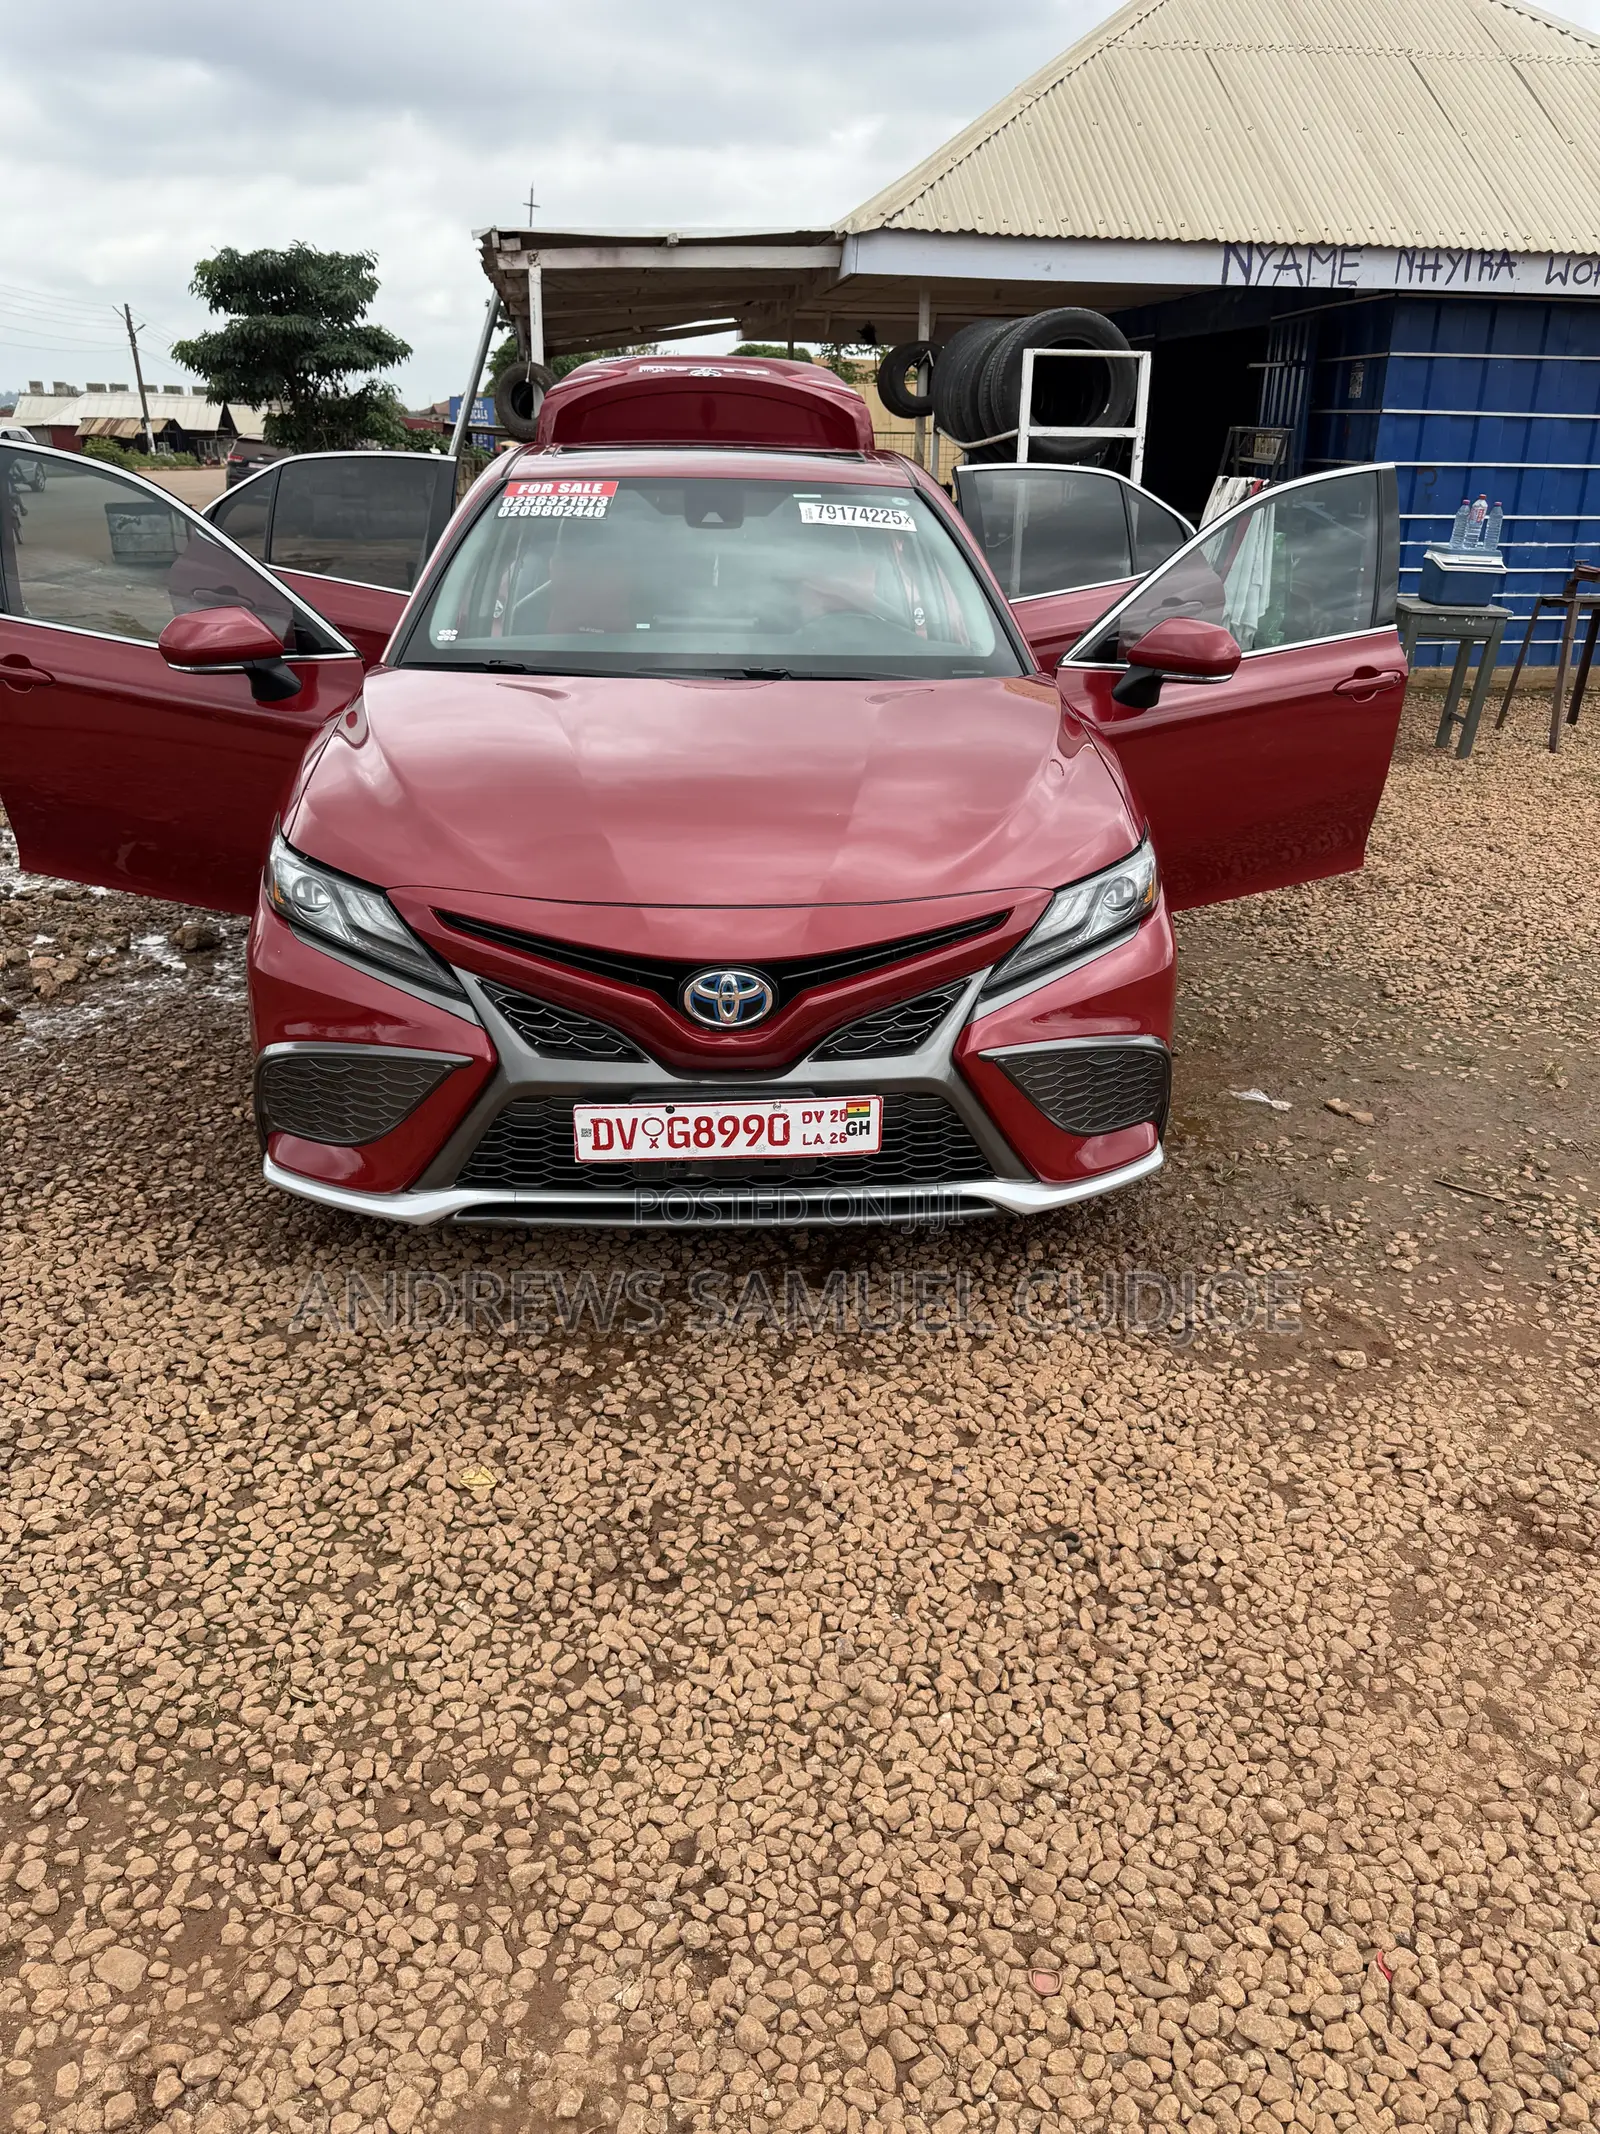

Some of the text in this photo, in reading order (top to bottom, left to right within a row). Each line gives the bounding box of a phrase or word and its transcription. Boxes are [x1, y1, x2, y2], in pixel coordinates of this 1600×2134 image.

[1222, 243, 1364, 287] NYAME
[1394, 248, 1518, 286] NHYIRA
[517, 483, 604, 494] FOR SALE
[801, 1108, 848, 1124] DV 20
[590, 1117, 638, 1150] DV
[667, 1113, 790, 1149] G8990
[845, 1120, 871, 1136] GH
[802, 1133, 825, 1146] LA
